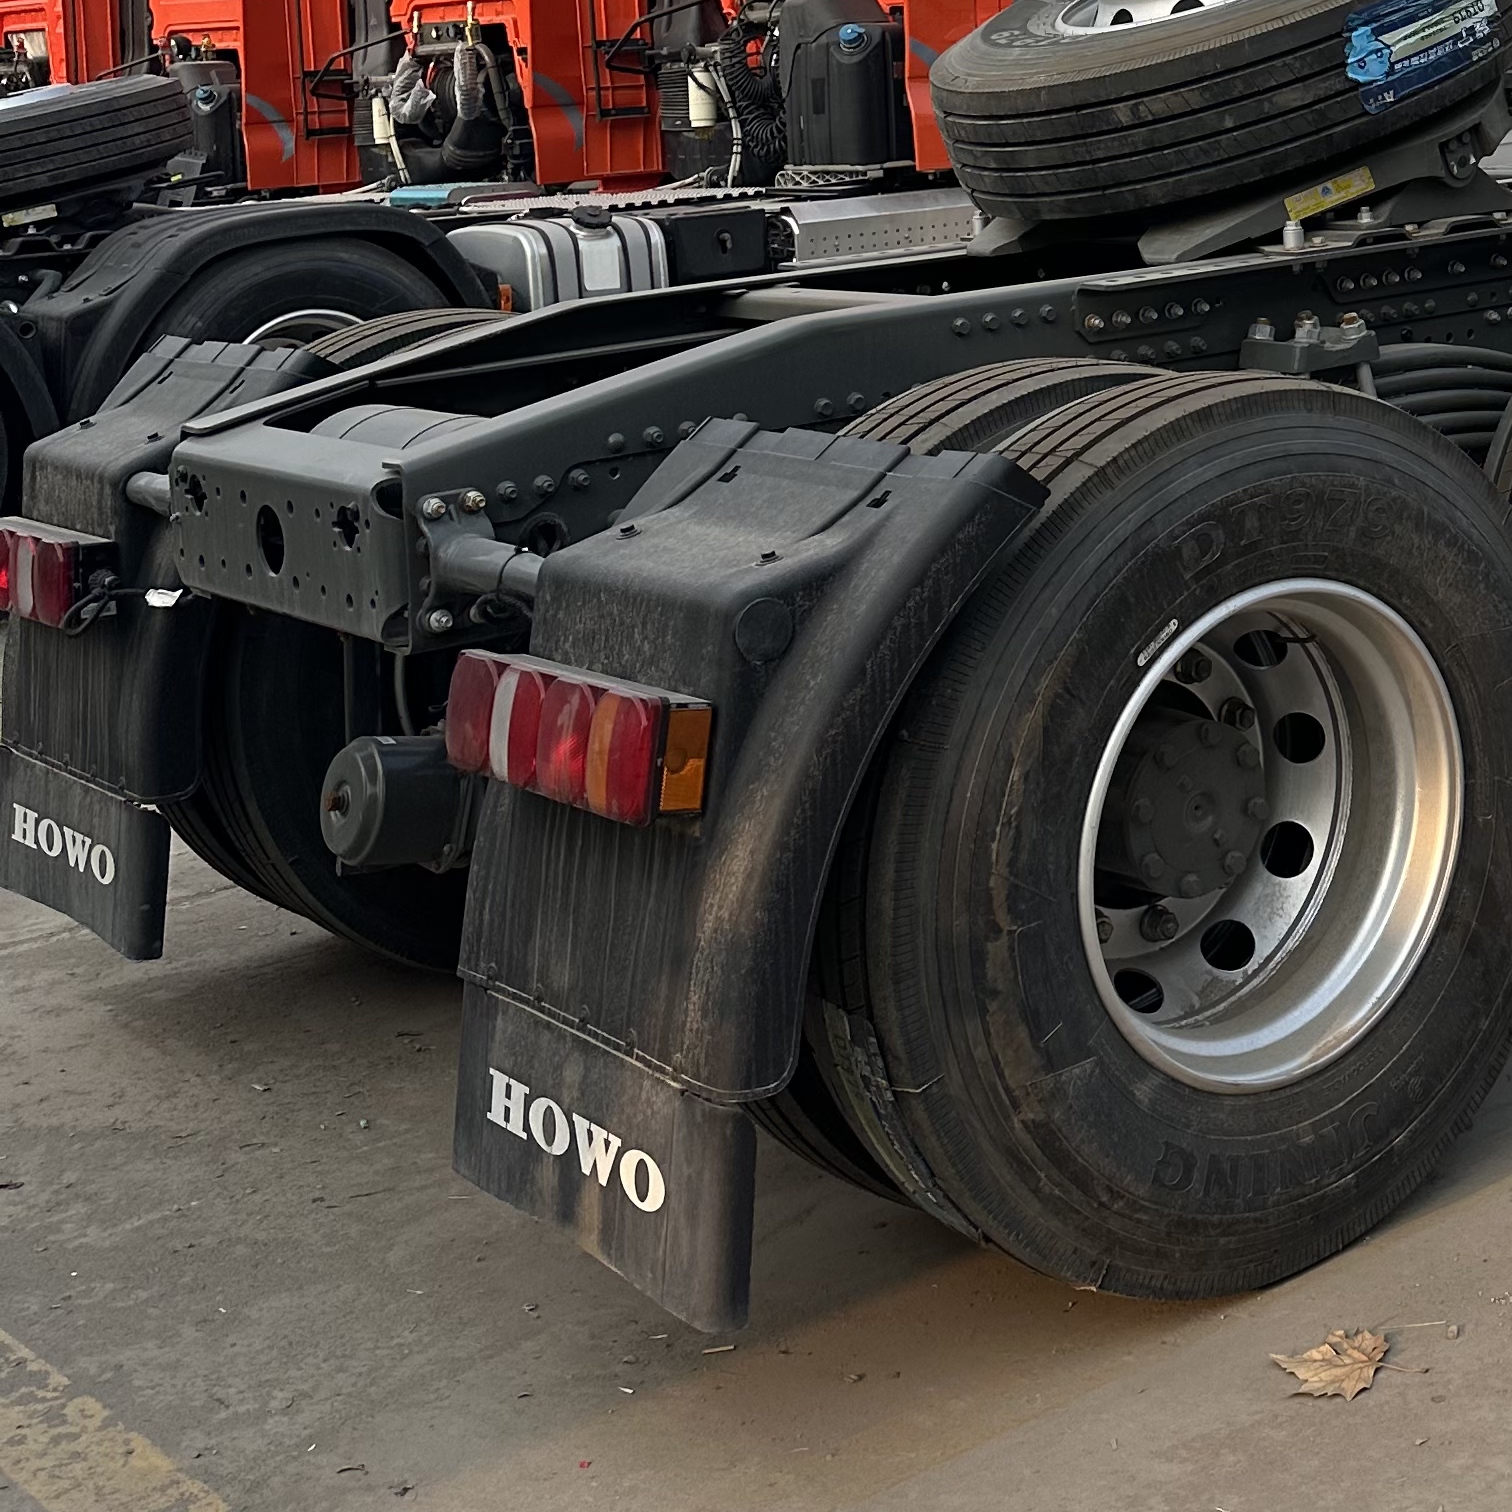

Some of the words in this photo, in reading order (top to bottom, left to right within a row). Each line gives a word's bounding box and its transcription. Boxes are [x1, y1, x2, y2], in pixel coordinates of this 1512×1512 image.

[1173, 486, 1397, 584] DT979
[11, 803, 116, 885] HOWO
[486, 1068, 666, 1213] HOWO
